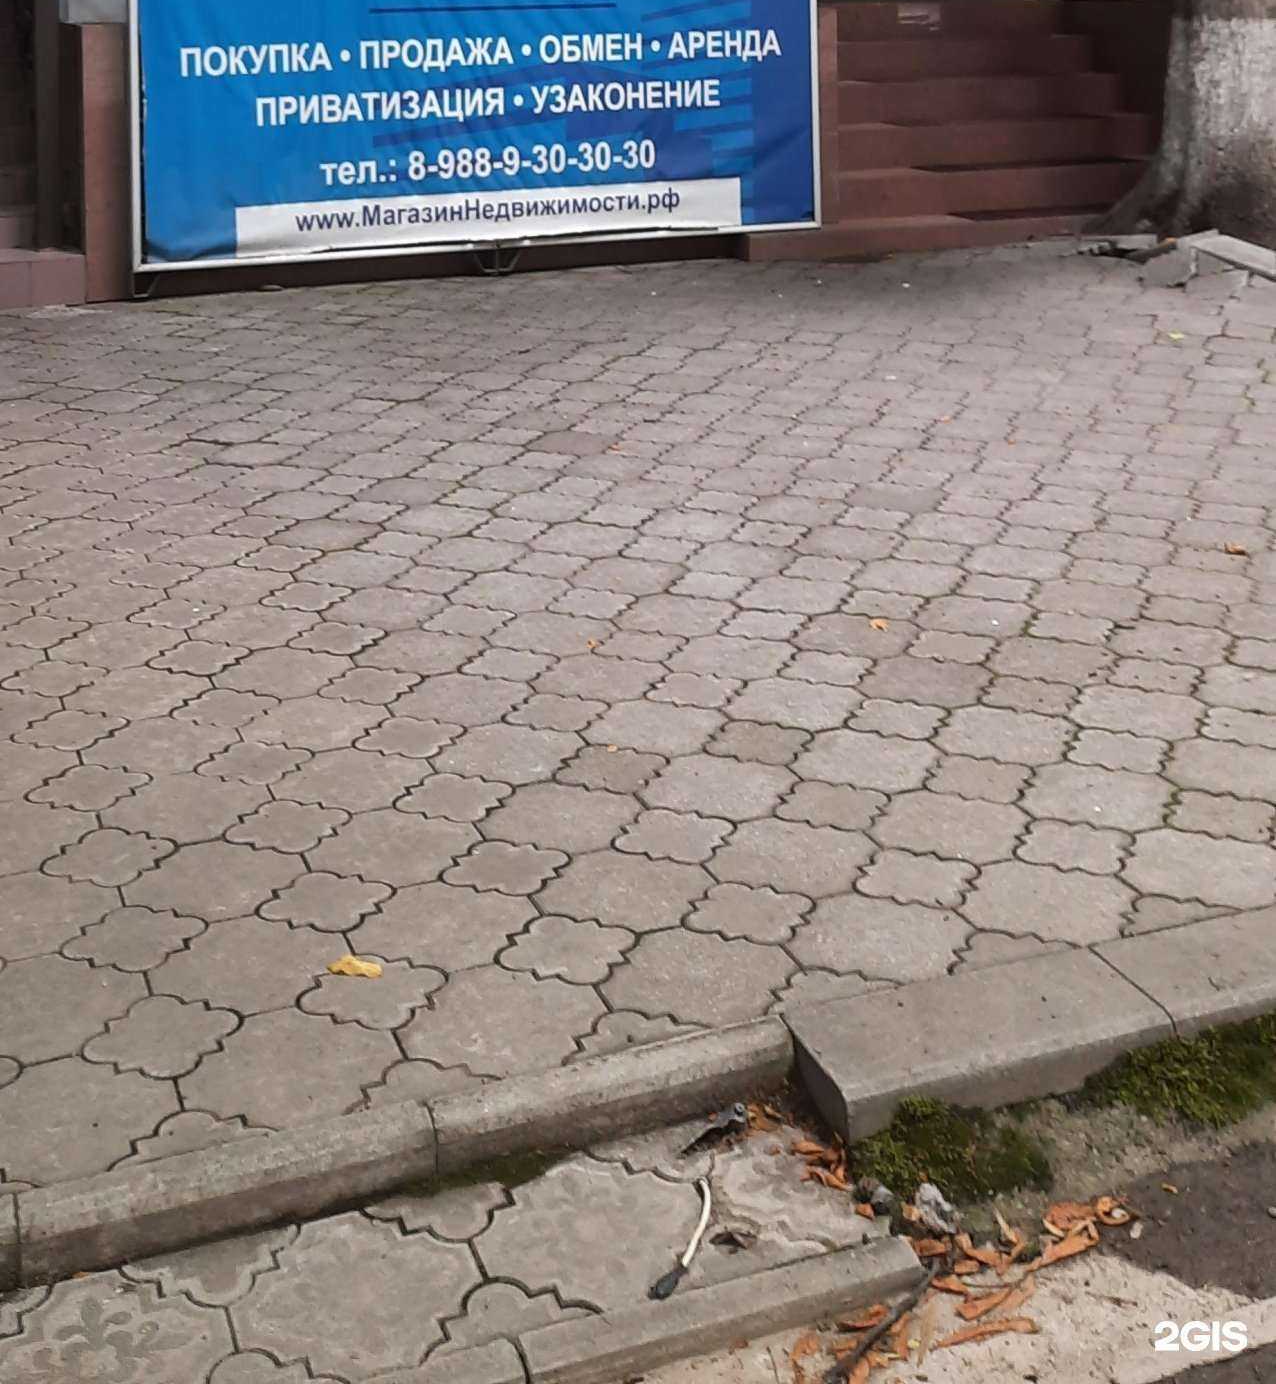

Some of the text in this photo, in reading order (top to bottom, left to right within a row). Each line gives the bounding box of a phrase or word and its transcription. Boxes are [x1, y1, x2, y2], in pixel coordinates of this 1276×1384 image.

[180, 29, 782, 77] ПОКУПКА ПРОДАЖА ОБМЕН АРЕНДА
[256, 79, 720, 127] ПРИВАТИЗАЦИЯ УЗАКОНЕНИЕ
[319, 139, 656, 186] тел.: 8-988-9-30-30-30
[295, 187, 680, 232] www.МагазинНедвижимости.рф
